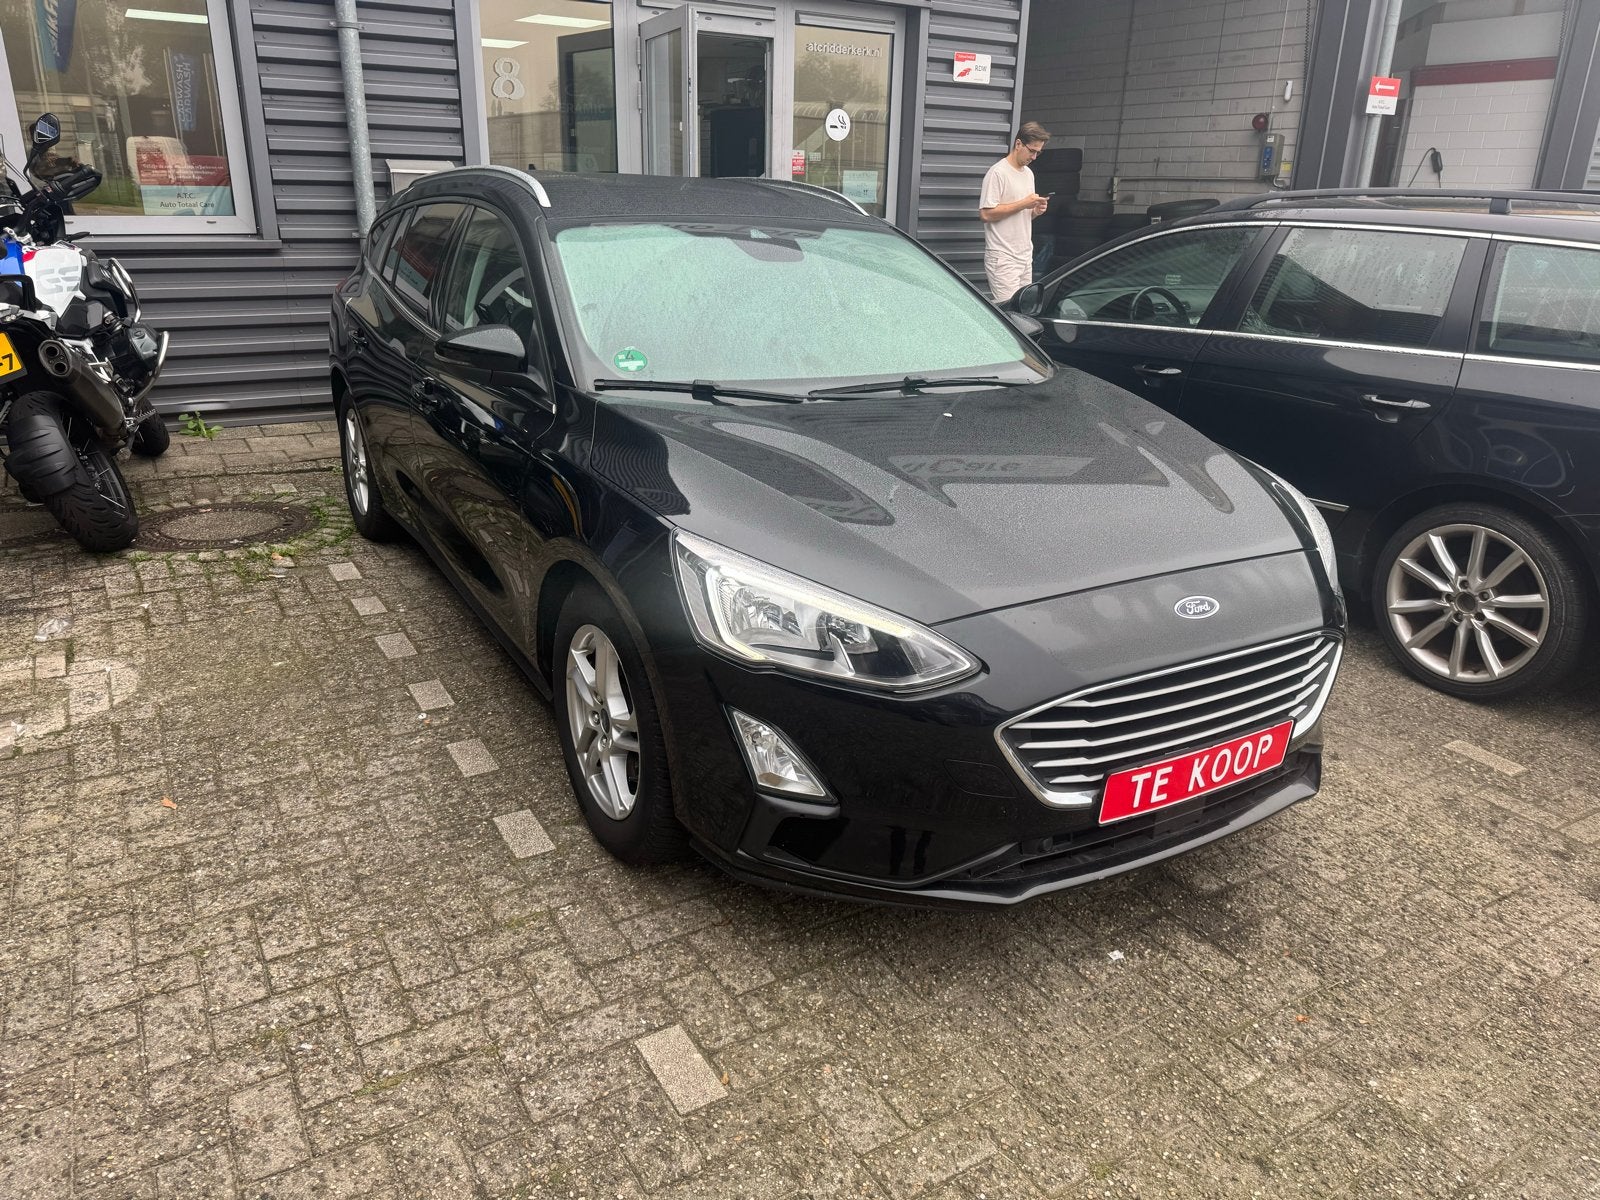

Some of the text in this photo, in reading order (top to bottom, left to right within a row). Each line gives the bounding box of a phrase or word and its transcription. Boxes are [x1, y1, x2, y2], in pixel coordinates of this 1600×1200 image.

[806, 41, 883, 57] atcridderkerk.nl
[491, 57, 526, 100] 8
[1186, 600, 1210, 614] Ford
[1131, 733, 1273, 808] TE KOOP
